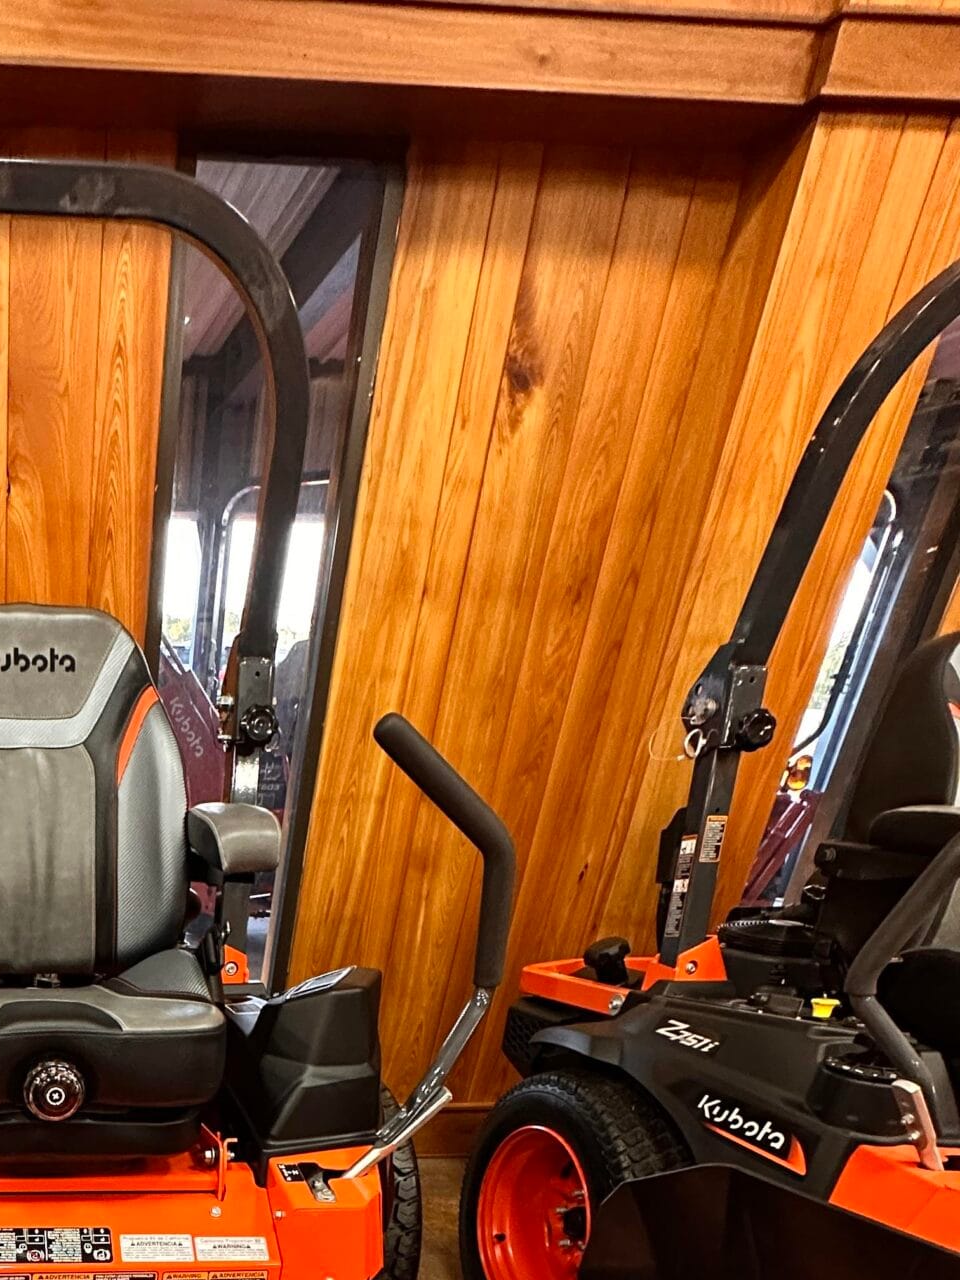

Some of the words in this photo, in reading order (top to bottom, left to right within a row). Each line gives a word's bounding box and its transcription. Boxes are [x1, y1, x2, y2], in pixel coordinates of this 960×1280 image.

[170, 696, 204, 758] Kubota
[654, 1018, 721, 1053] Z751i
[696, 1094, 786, 1150] Kubota
